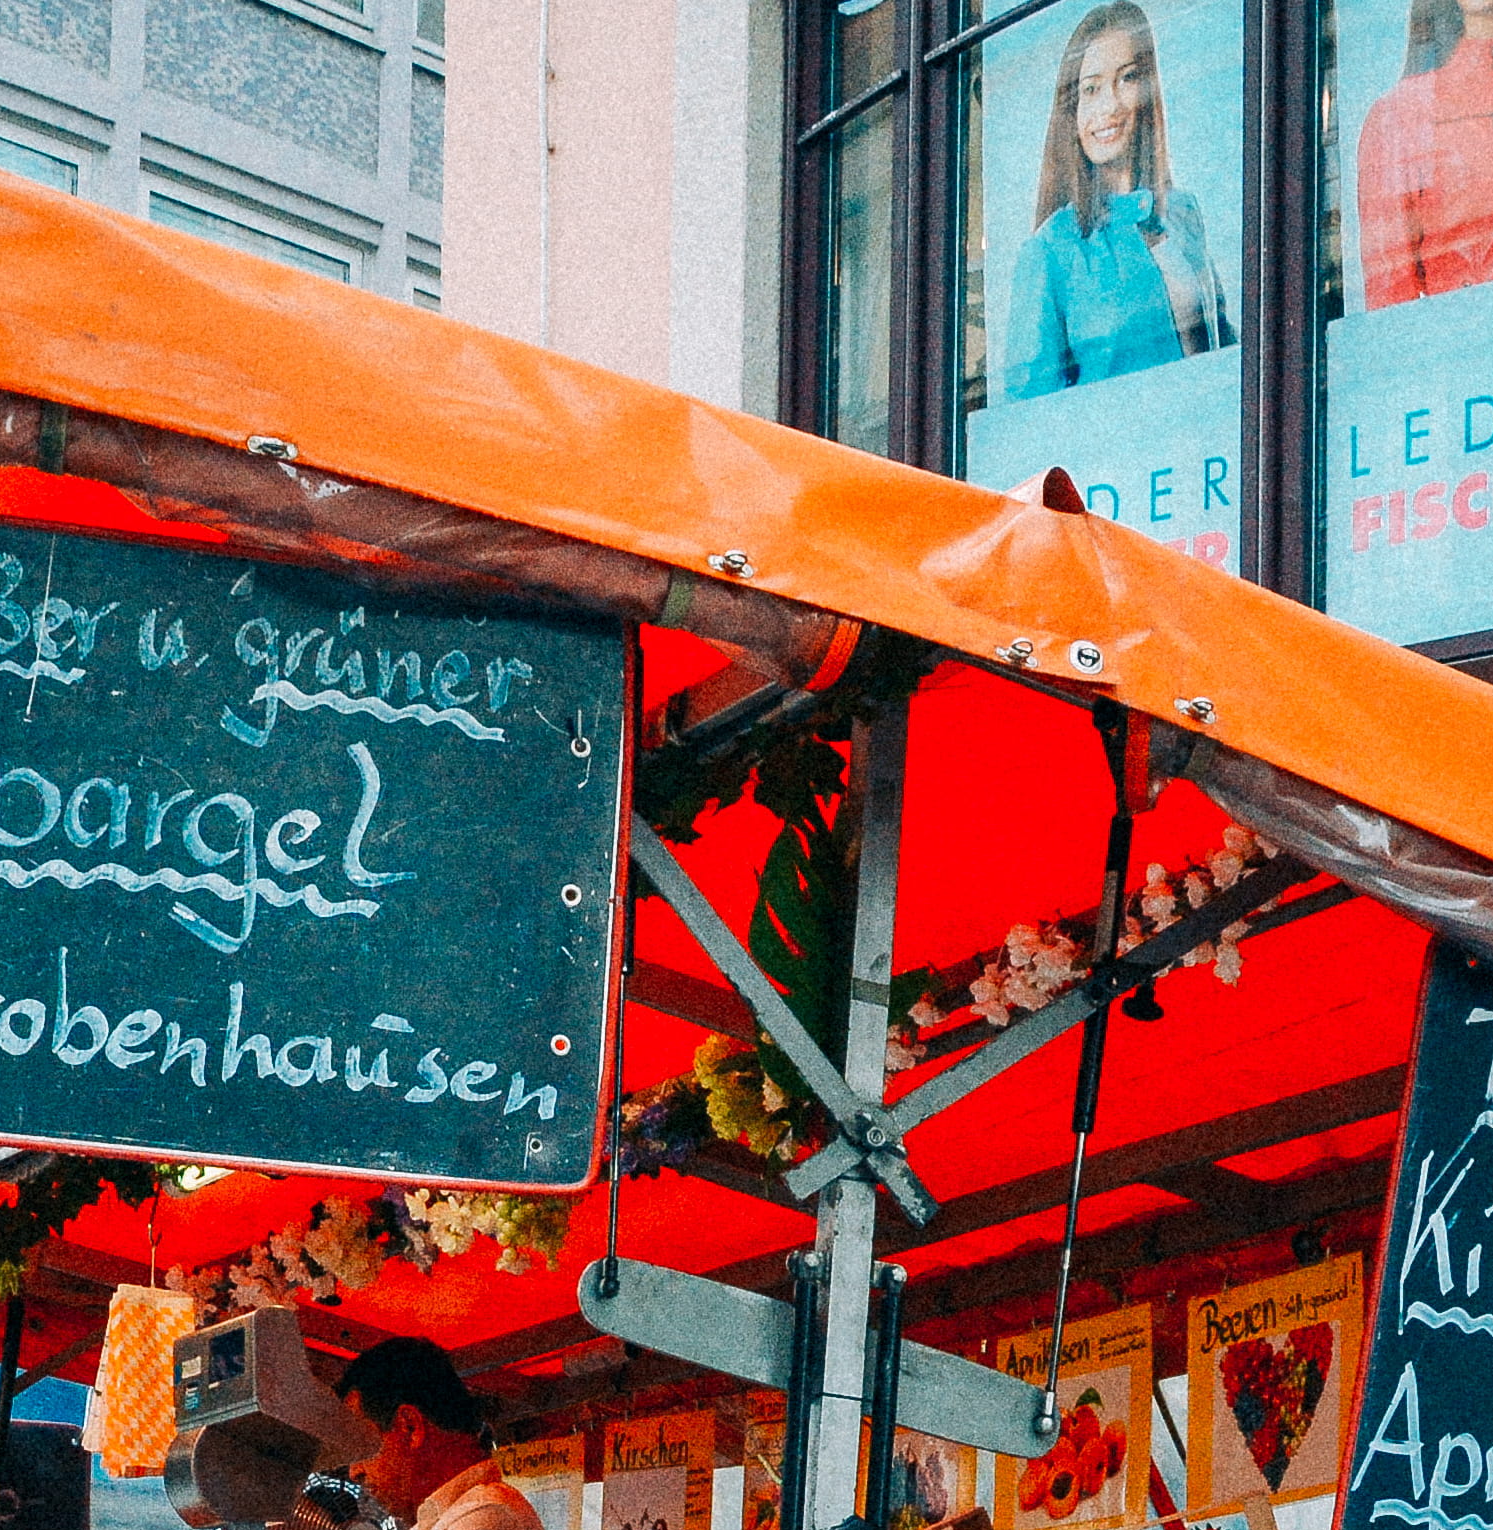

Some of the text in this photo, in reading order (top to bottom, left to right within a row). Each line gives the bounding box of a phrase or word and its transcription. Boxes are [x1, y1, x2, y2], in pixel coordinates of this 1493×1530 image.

[1087, 456, 1231, 522] DER
[220, 590, 533, 747] grüner
[1198, 1299, 1276, 1354] Beeren
[612, 1423, 689, 1475] Kirschen
